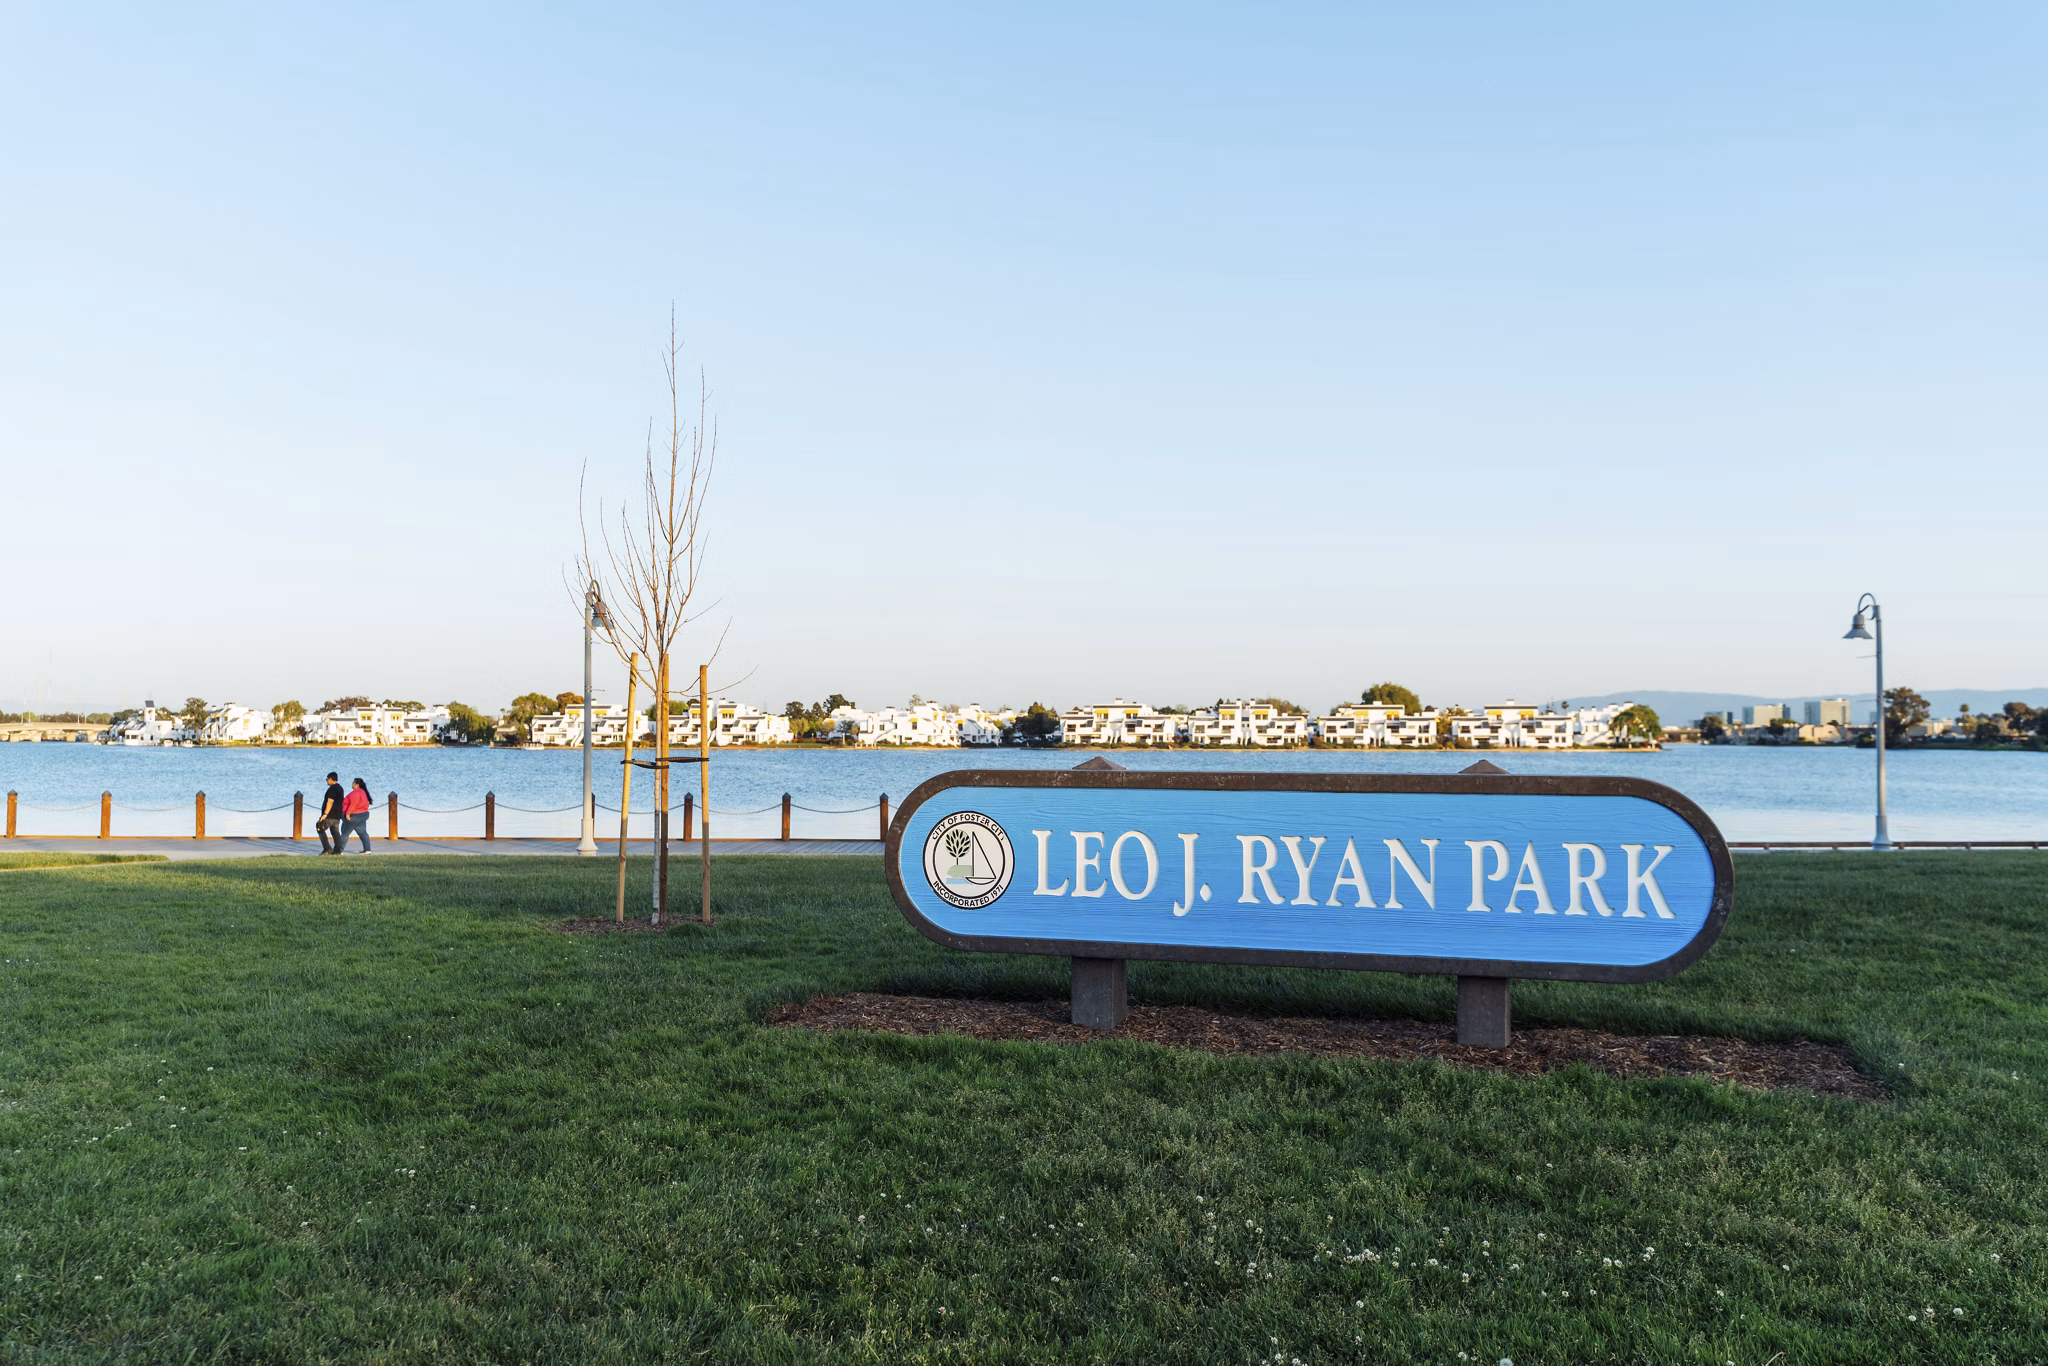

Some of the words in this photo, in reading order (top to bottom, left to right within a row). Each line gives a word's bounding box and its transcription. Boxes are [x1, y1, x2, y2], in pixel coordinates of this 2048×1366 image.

[932, 822, 946, 840] CITY
[948, 816, 958, 825] OF
[960, 814, 990, 826] FOSTER
[1032, 829, 1158, 901] LEO
[1173, 833, 1211, 918] J.
[1236, 835, 1438, 910] RYAN
[1465, 840, 1674, 919] PARK
[933, 880, 989, 906] INCORPORATED
[990, 884, 1003, 898] 1971
